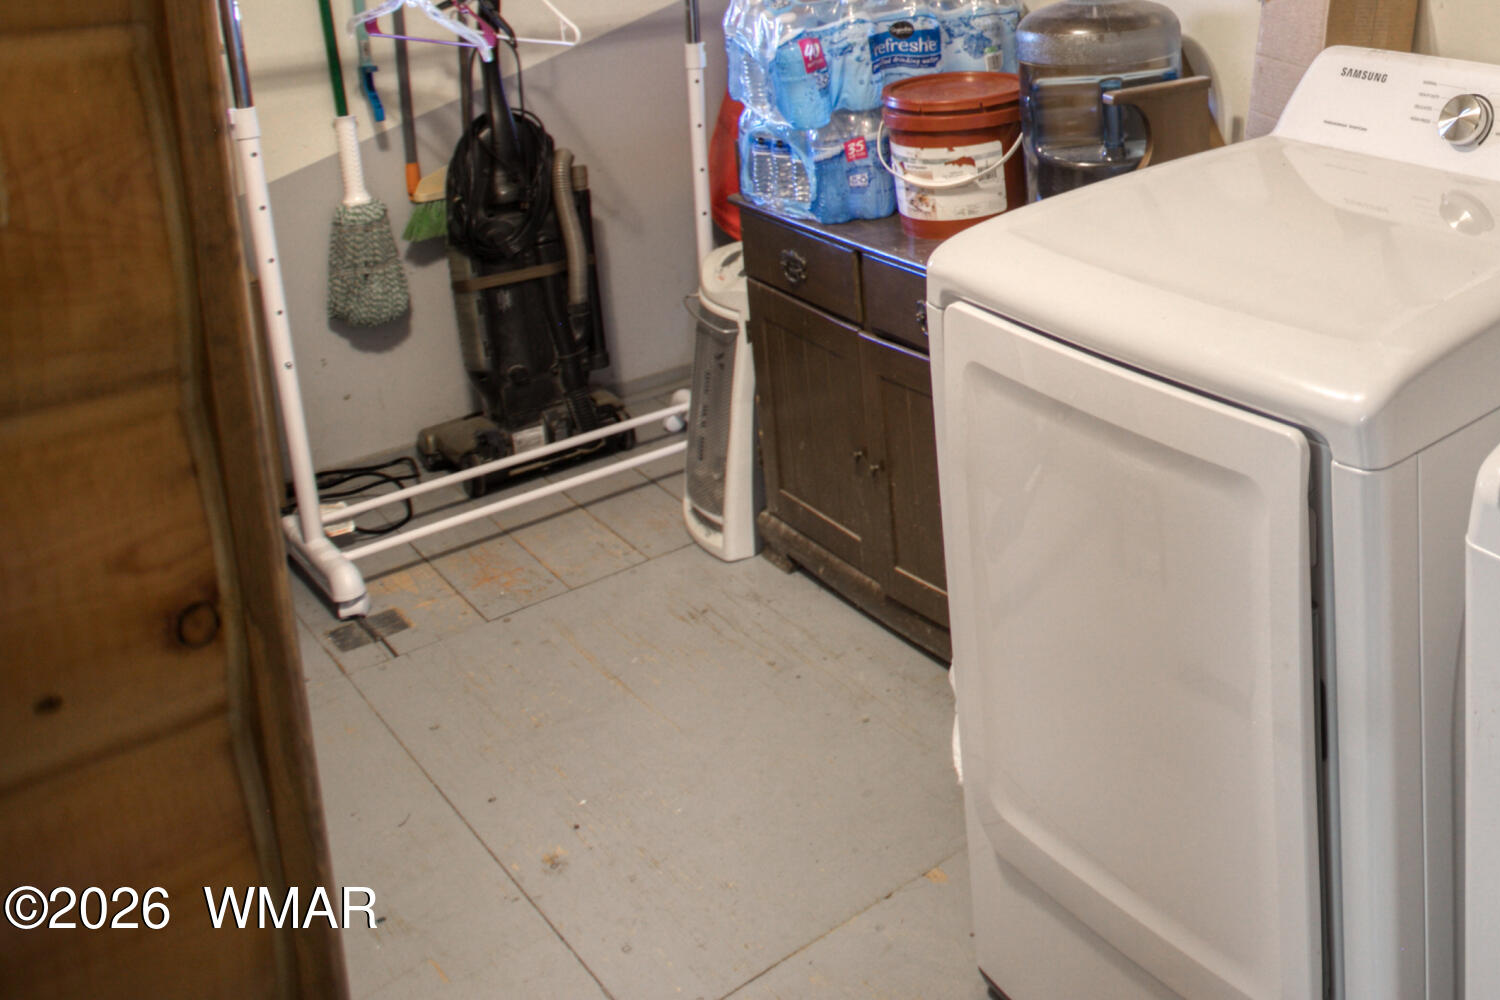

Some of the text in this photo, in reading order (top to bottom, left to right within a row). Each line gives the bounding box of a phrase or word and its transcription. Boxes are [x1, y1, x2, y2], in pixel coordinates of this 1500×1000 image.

[804, 42, 820, 62] 40
[1340, 66, 1389, 84] SAMSUNG
[847, 139, 866, 155] 35
